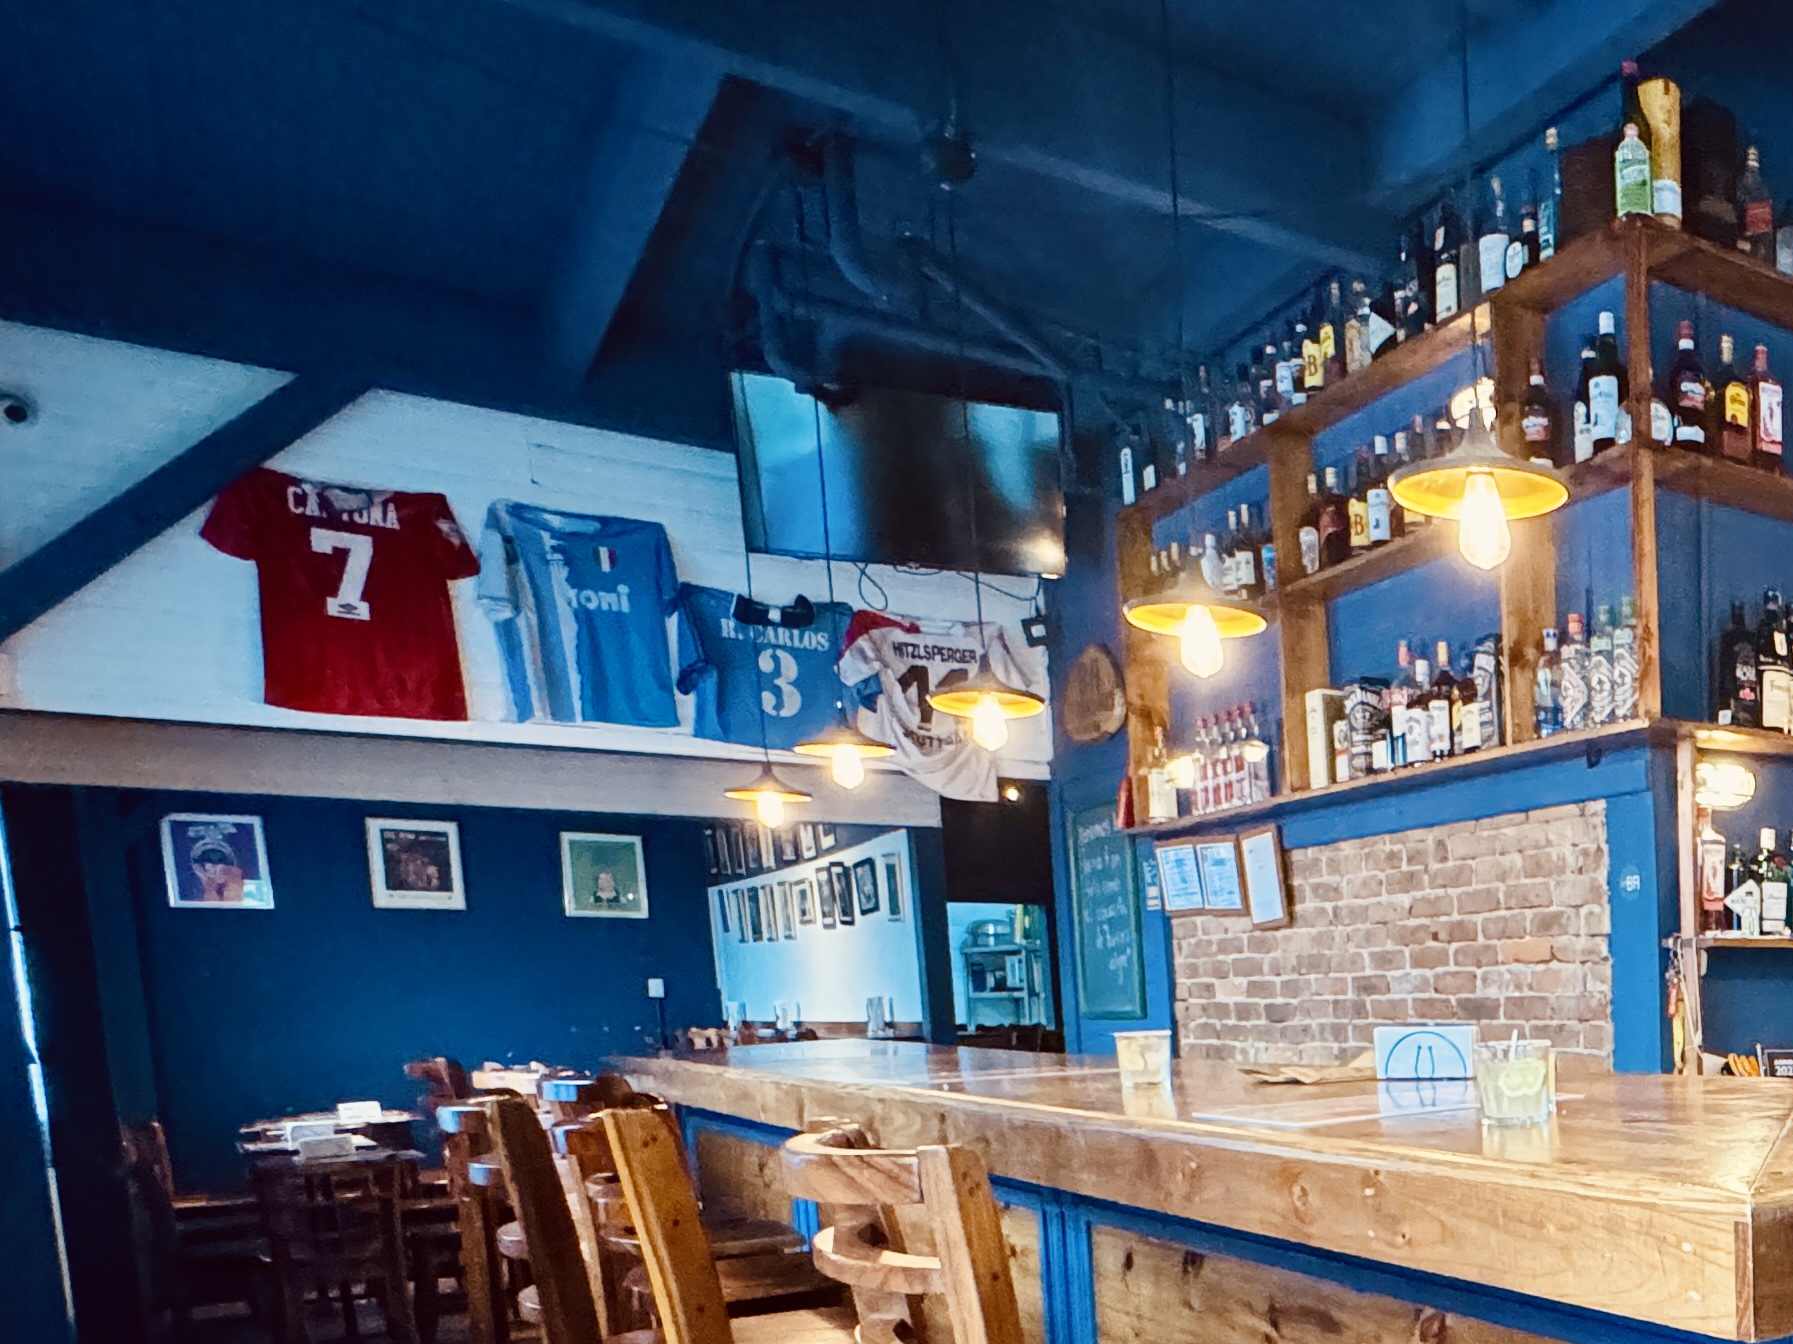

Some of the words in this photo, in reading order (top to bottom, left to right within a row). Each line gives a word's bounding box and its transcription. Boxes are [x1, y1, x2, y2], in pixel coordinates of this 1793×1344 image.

[287, 482, 400, 531] CAONA
[310, 526, 374, 621] 7
[749, 624, 831, 652] CARLOS
[891, 641, 978, 664] HITZLSPERGER
[758, 648, 803, 719] 3
